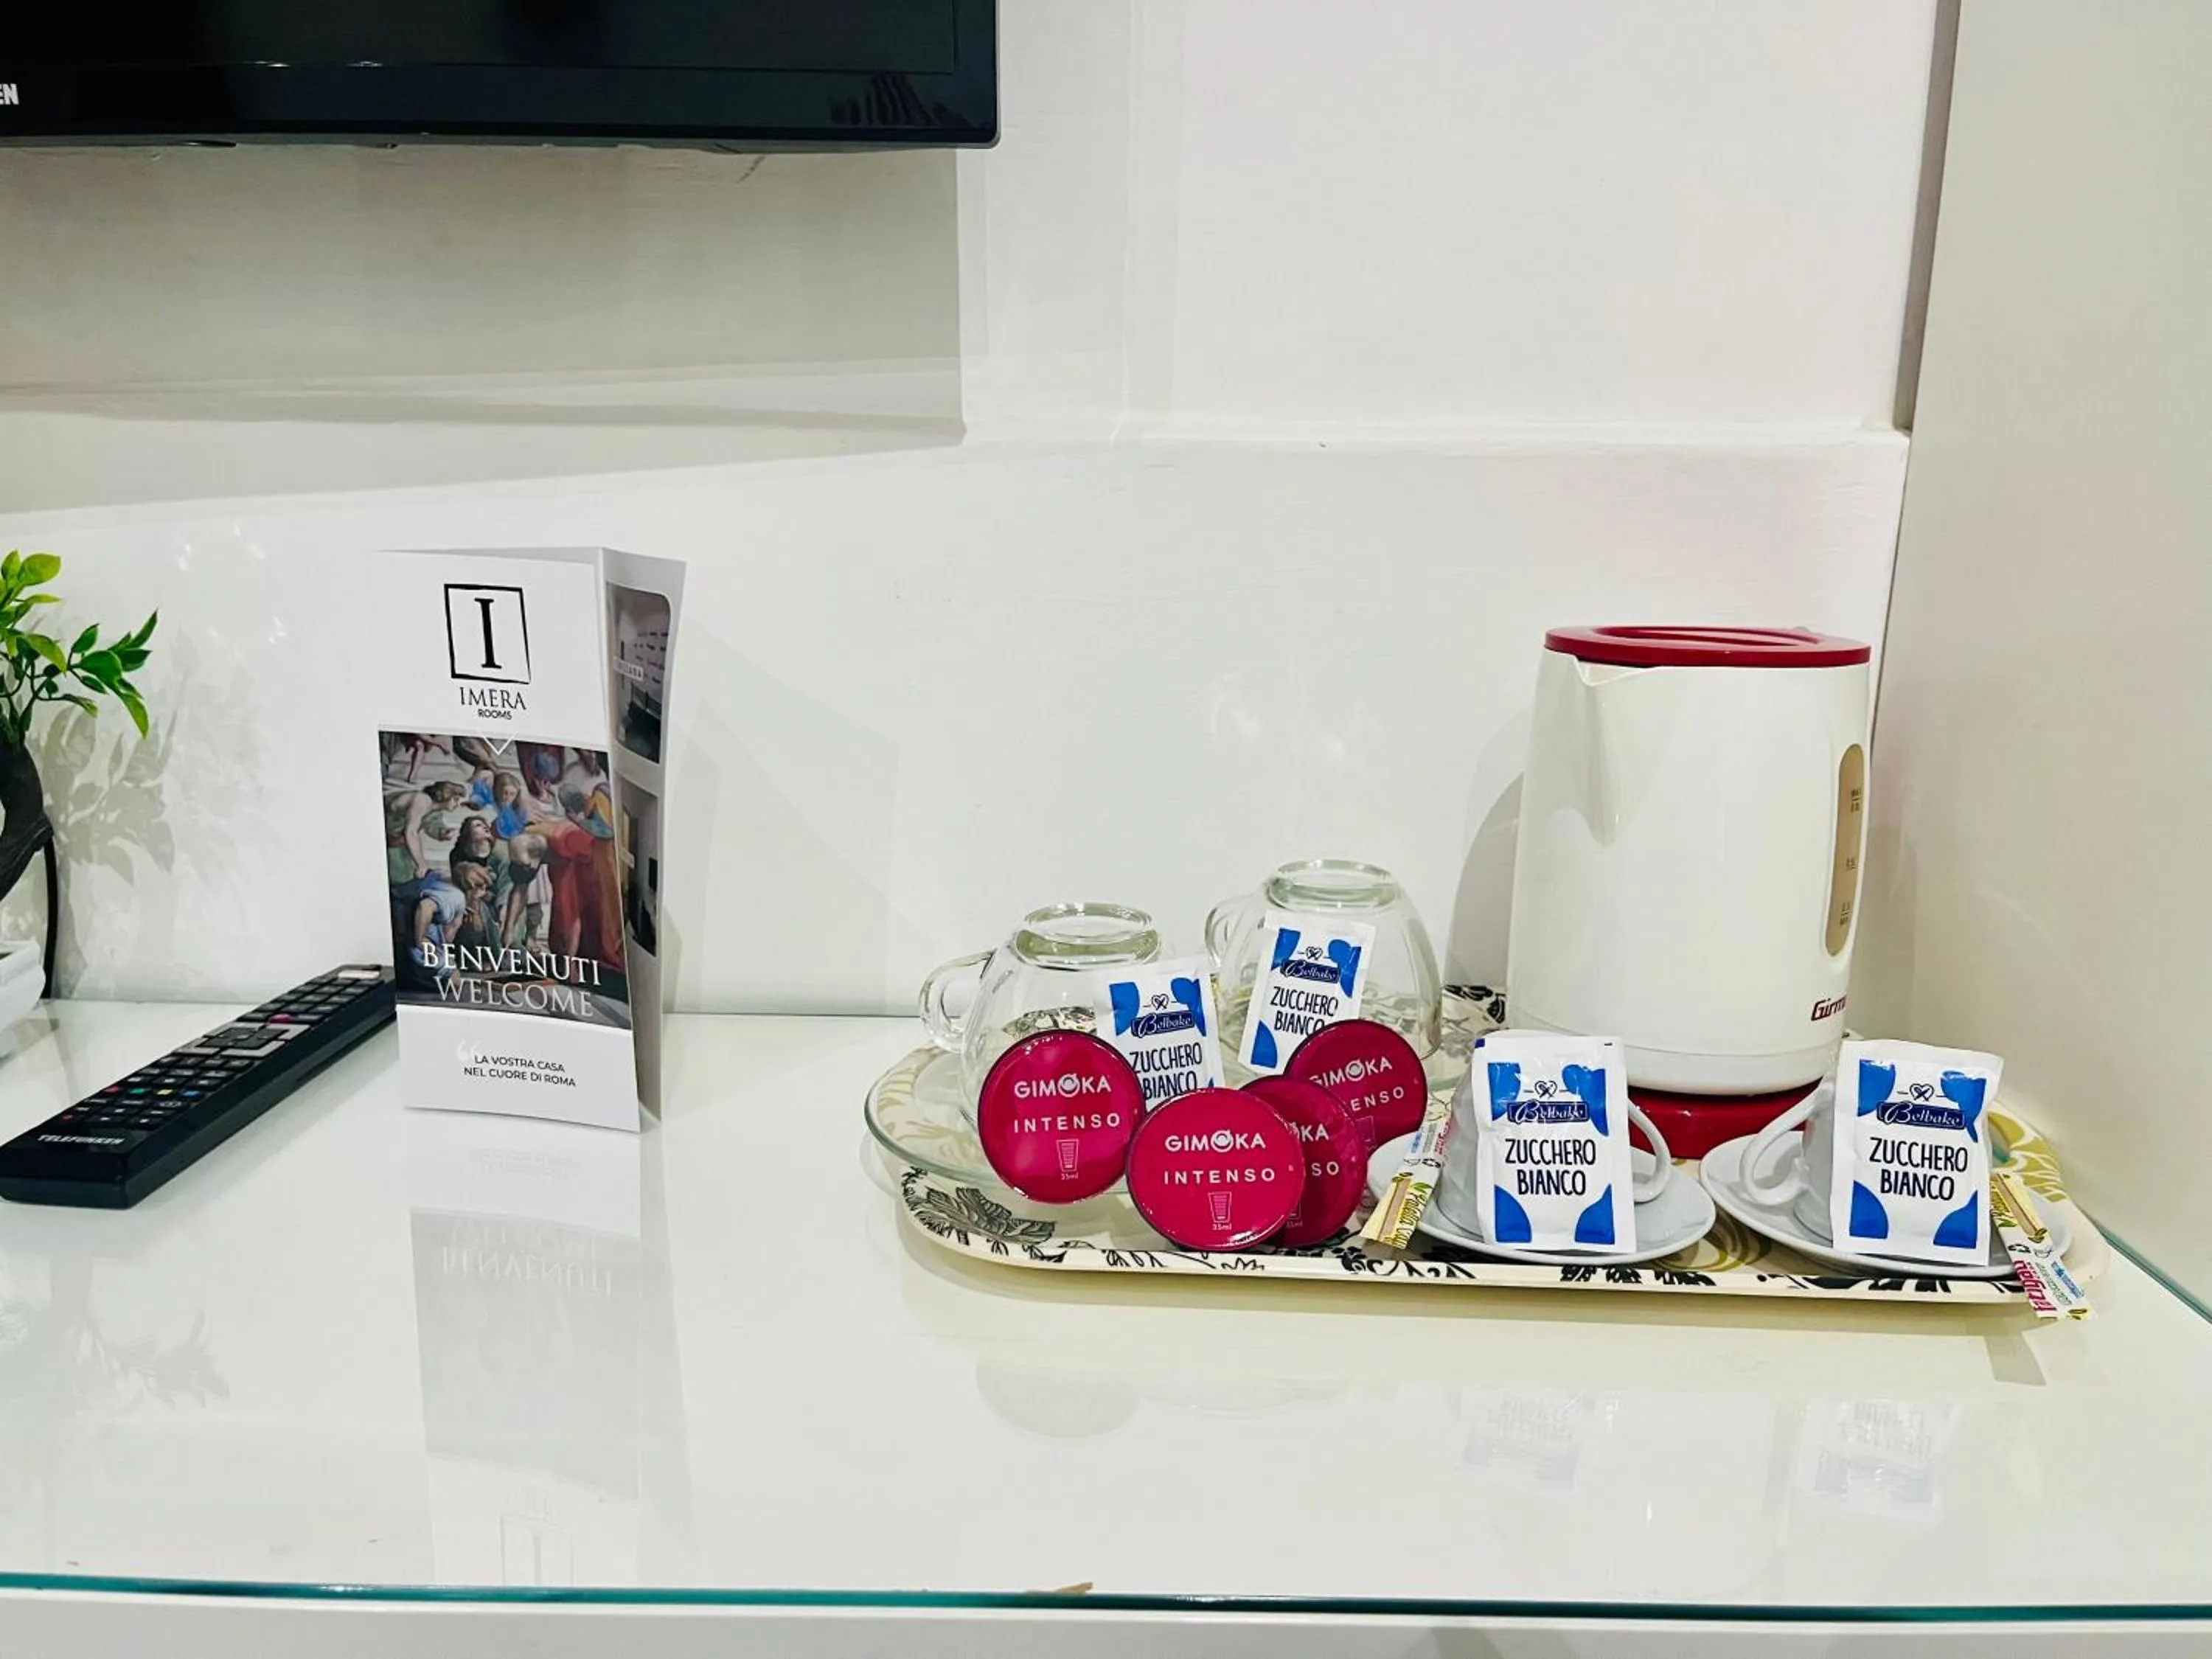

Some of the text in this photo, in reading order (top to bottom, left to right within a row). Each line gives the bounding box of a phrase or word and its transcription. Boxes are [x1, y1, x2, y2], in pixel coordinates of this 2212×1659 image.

[474, 598, 501, 669] I
[460, 686, 526, 710] IMERA
[478, 709, 512, 720] ROOMS
[423, 942, 601, 986] BENVENUTI
[434, 976, 594, 1017] WELCOME
[1270, 986, 1339, 1017] ZUCCHERO
[1138, 1013, 1192, 1038] Belbake
[474, 1055, 566, 1072] LA VOSTRA CASA
[1129, 1042, 1203, 1074] ZUCCHERO
[464, 1067, 577, 1087] NEL CUORE DI ROMA
[1014, 1073, 1112, 1098] GIMOKA
[1142, 1071, 1197, 1100] BIANCO
[1350, 1086, 1405, 1111] ENSO
[1014, 1113, 1120, 1133] INTENSO
[1884, 1101, 1961, 1126] Belbake
[37, 1135, 125, 1145] TELEFUNKEN
[1164, 1129, 1266, 1152] GIMOKA
[1505, 1138, 1596, 1166] ZUCCHERO
[1869, 1136, 1968, 1172] ZUCCHERO
[1164, 1168, 1275, 1185] INTENSO
[1517, 1169, 1586, 1196] BIANCO
[1880, 1169, 1955, 1201] BIANCO
